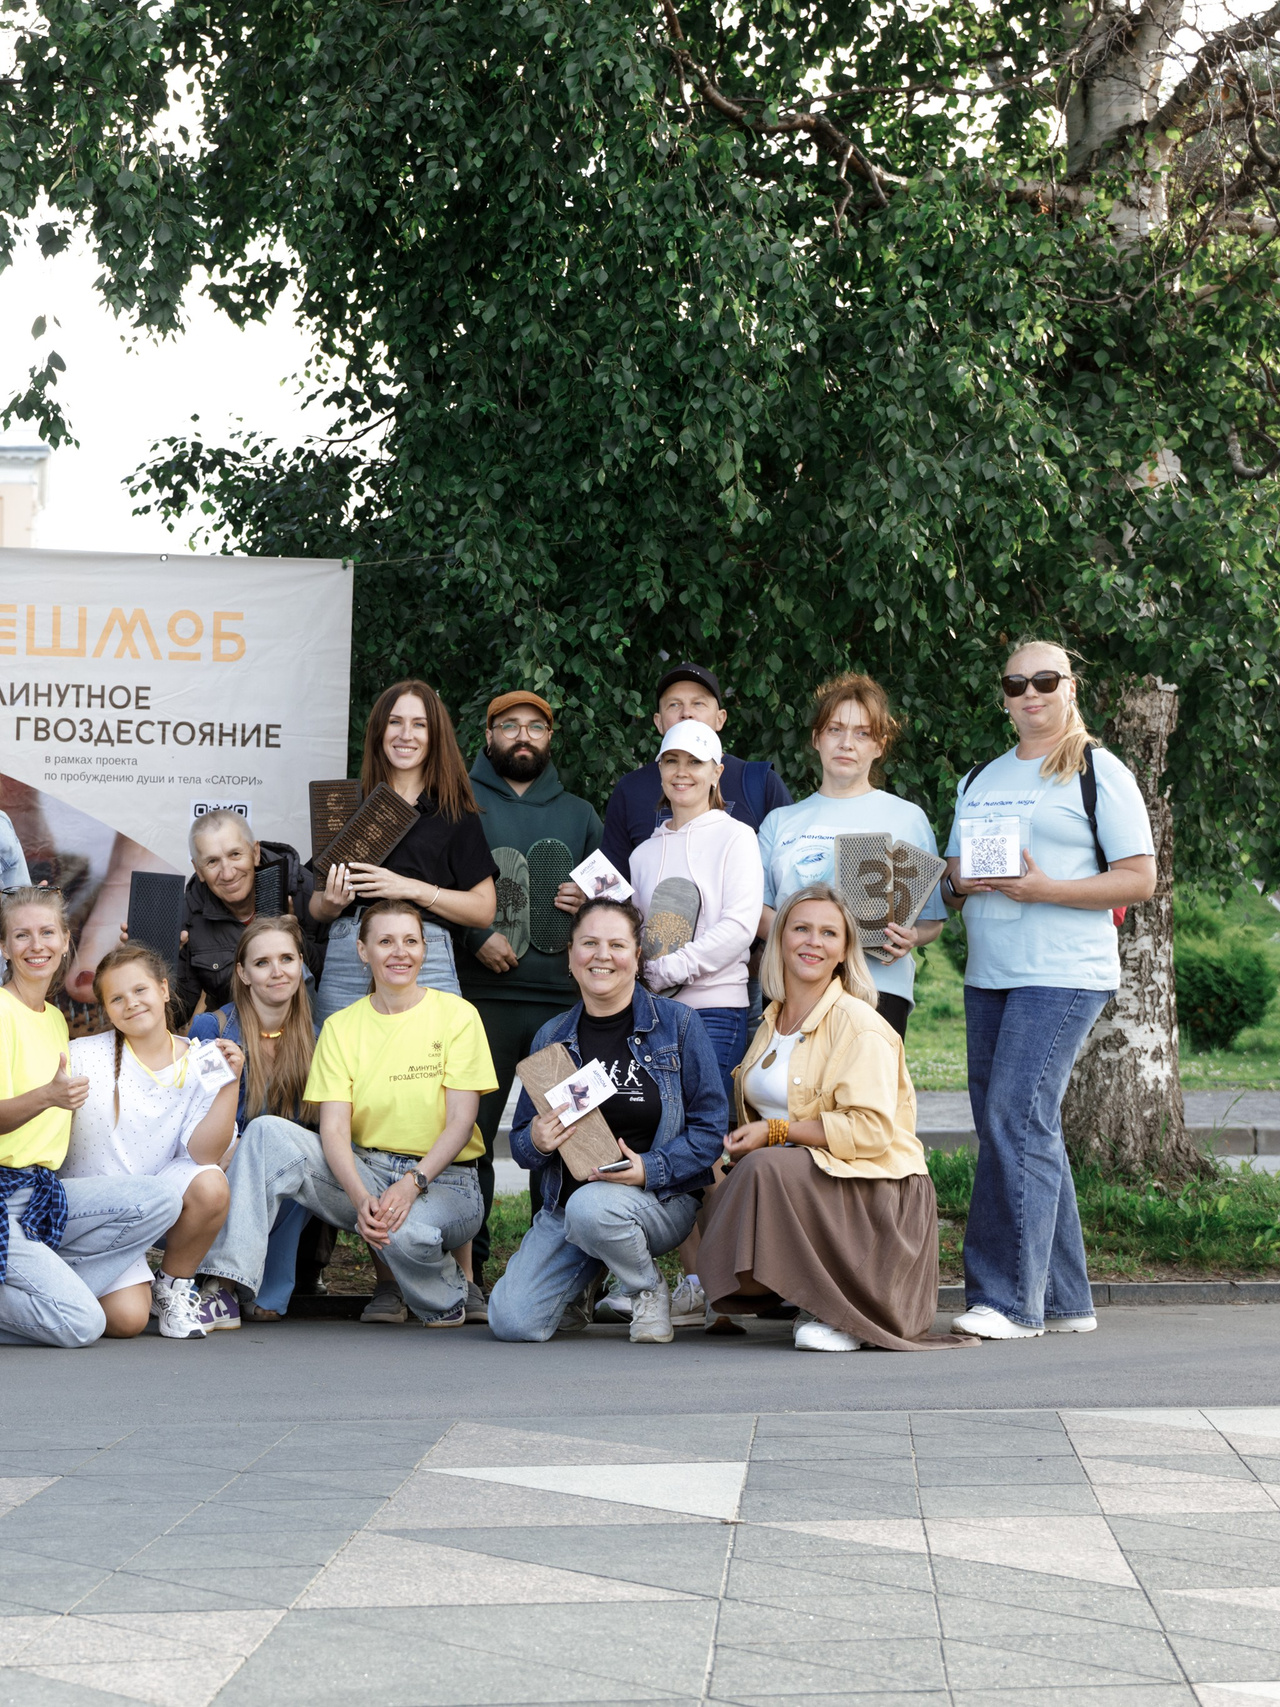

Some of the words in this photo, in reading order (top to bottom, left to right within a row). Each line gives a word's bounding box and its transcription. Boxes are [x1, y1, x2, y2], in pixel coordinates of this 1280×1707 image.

[15, 716, 282, 748] ГВОЗДЕСТОЯНИЕ
[44, 755, 51, 764] в
[54, 755, 93, 766] рамках
[95, 756, 138, 767] проекта
[44, 772, 57, 781] по
[60, 771, 134, 784] пробуждению
[136, 774, 165, 785] души
[168, 775, 175, 784] и
[177, 775, 202, 785] тела
[204, 774, 263, 786] «САТОРИ»
[408, 1062, 442, 1072] МИНУТНЕ
